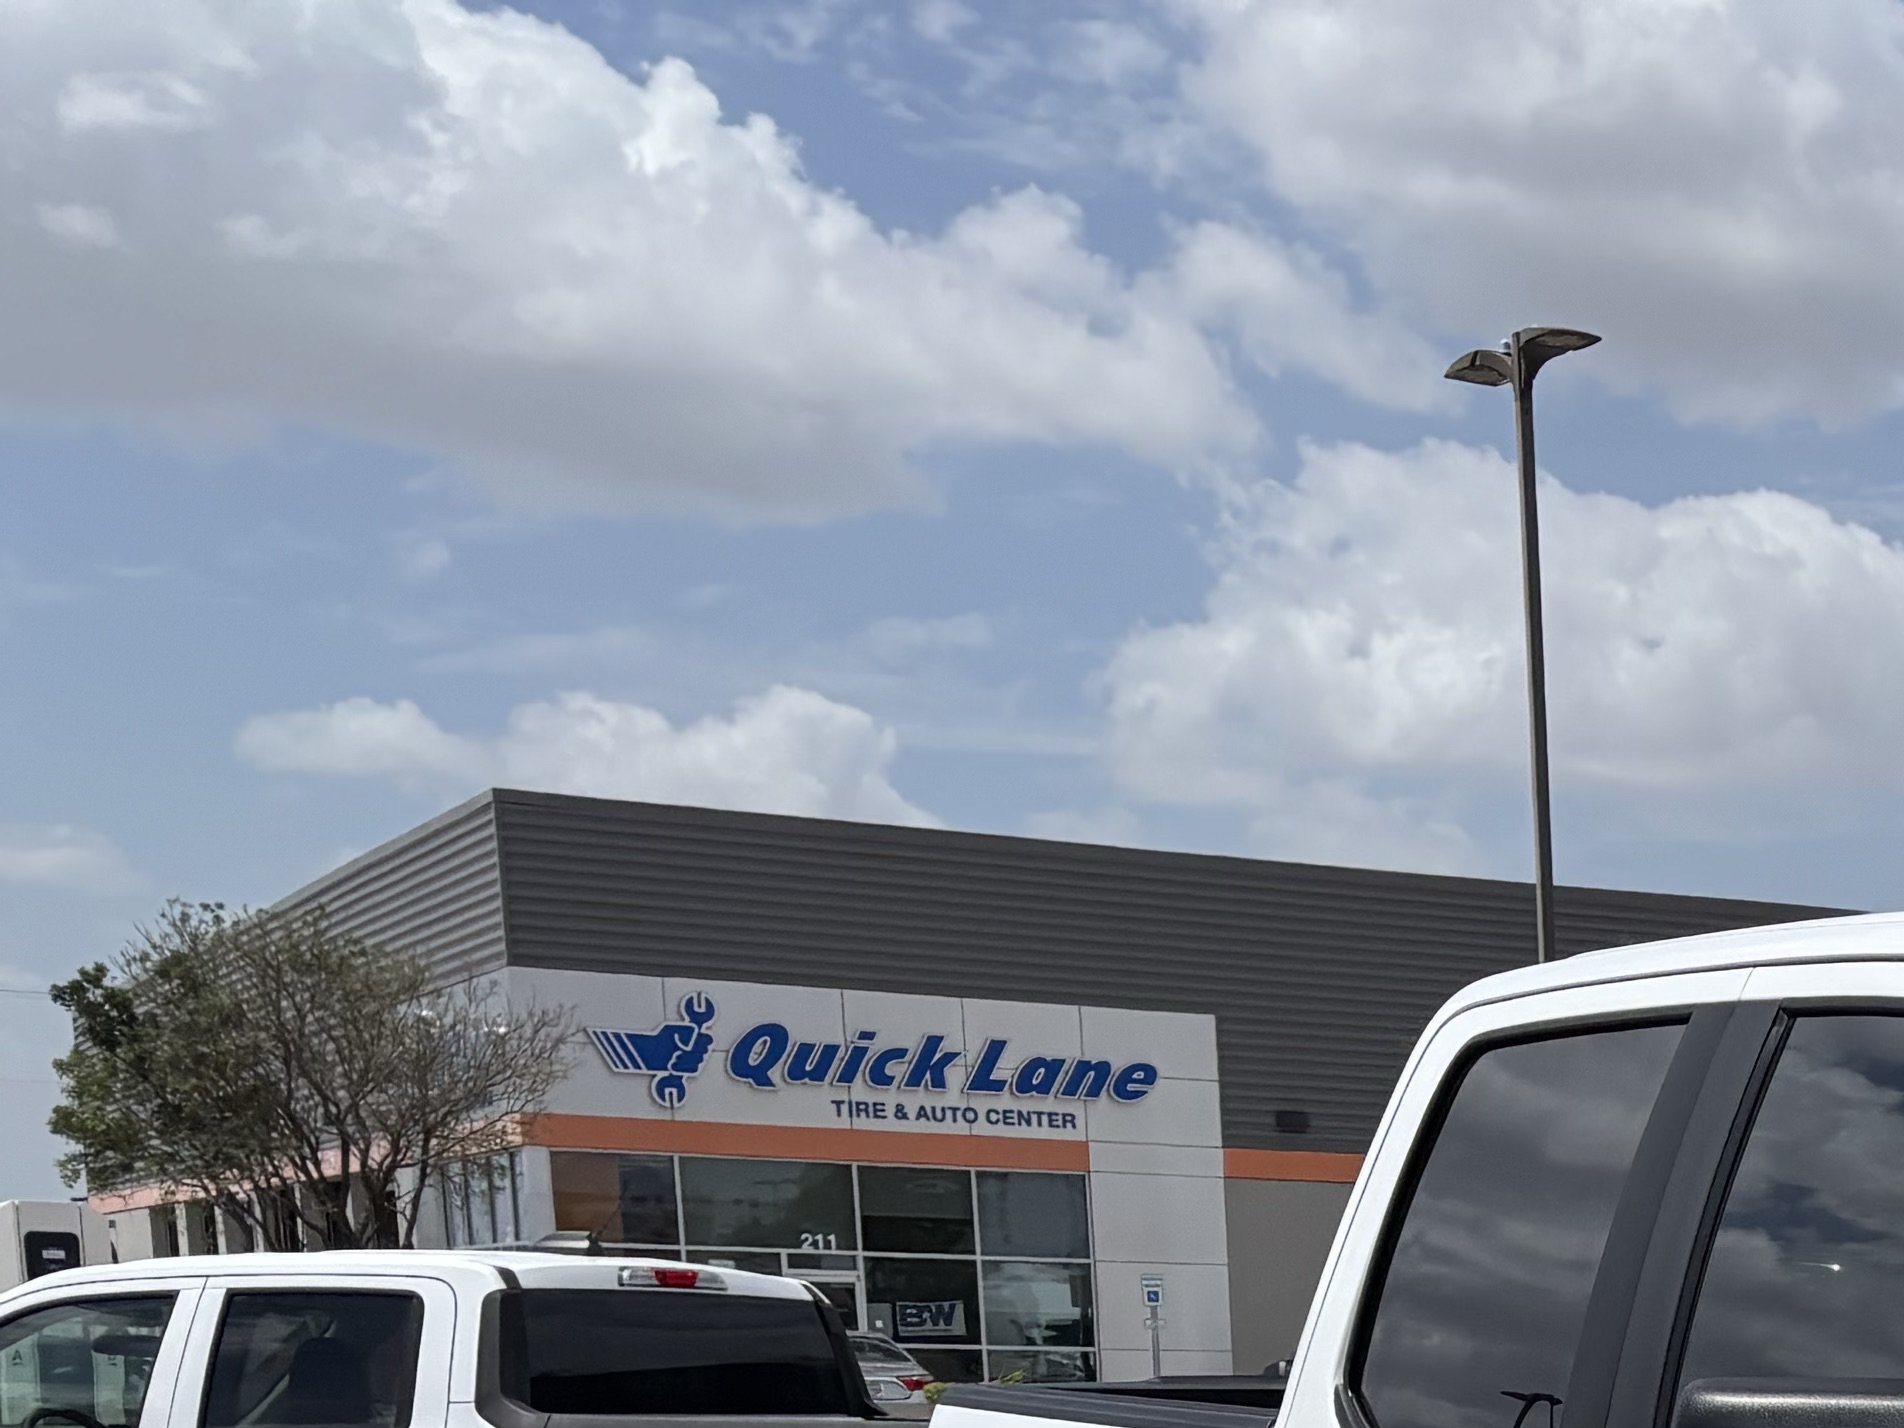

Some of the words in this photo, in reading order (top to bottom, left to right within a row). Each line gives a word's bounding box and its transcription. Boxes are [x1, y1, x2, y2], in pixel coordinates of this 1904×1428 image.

[728, 1021, 964, 1091] Quick
[964, 1037, 1159, 1102] Lane
[831, 1099, 888, 1120] TIRE
[893, 1103, 910, 1121] &
[915, 1105, 979, 1125] AUTO
[985, 1108, 1077, 1130] CENTER
[800, 1232, 837, 1250] 211
